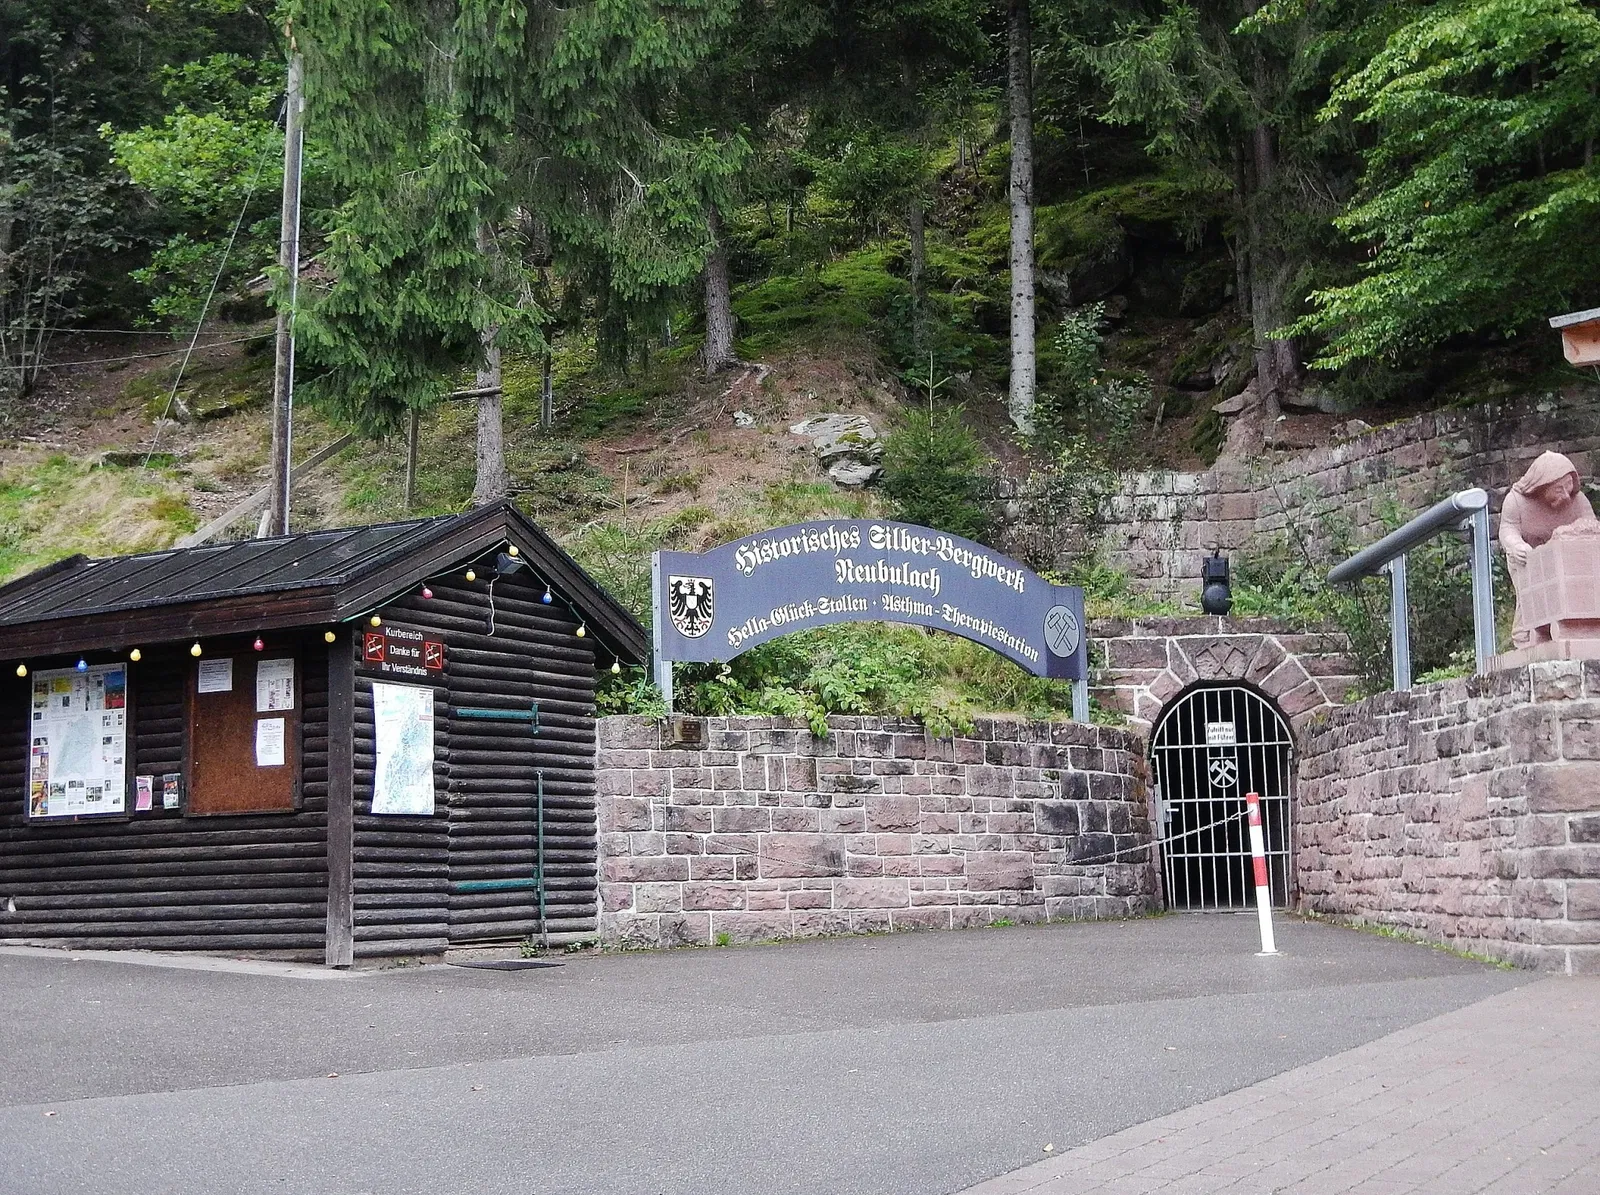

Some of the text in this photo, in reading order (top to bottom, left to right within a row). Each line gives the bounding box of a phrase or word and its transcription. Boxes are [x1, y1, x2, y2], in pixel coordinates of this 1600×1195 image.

[734, 524, 1025, 594] Historisches Silber-Bergwerk
[834, 558, 942, 597] Neubulach
[385, 626, 423, 640] Kurbereich
[727, 594, 868, 649] Hella-Glück-Stollen
[390, 645, 421, 657] Danke für
[381, 661, 428, 676] Ihr Verständnis
